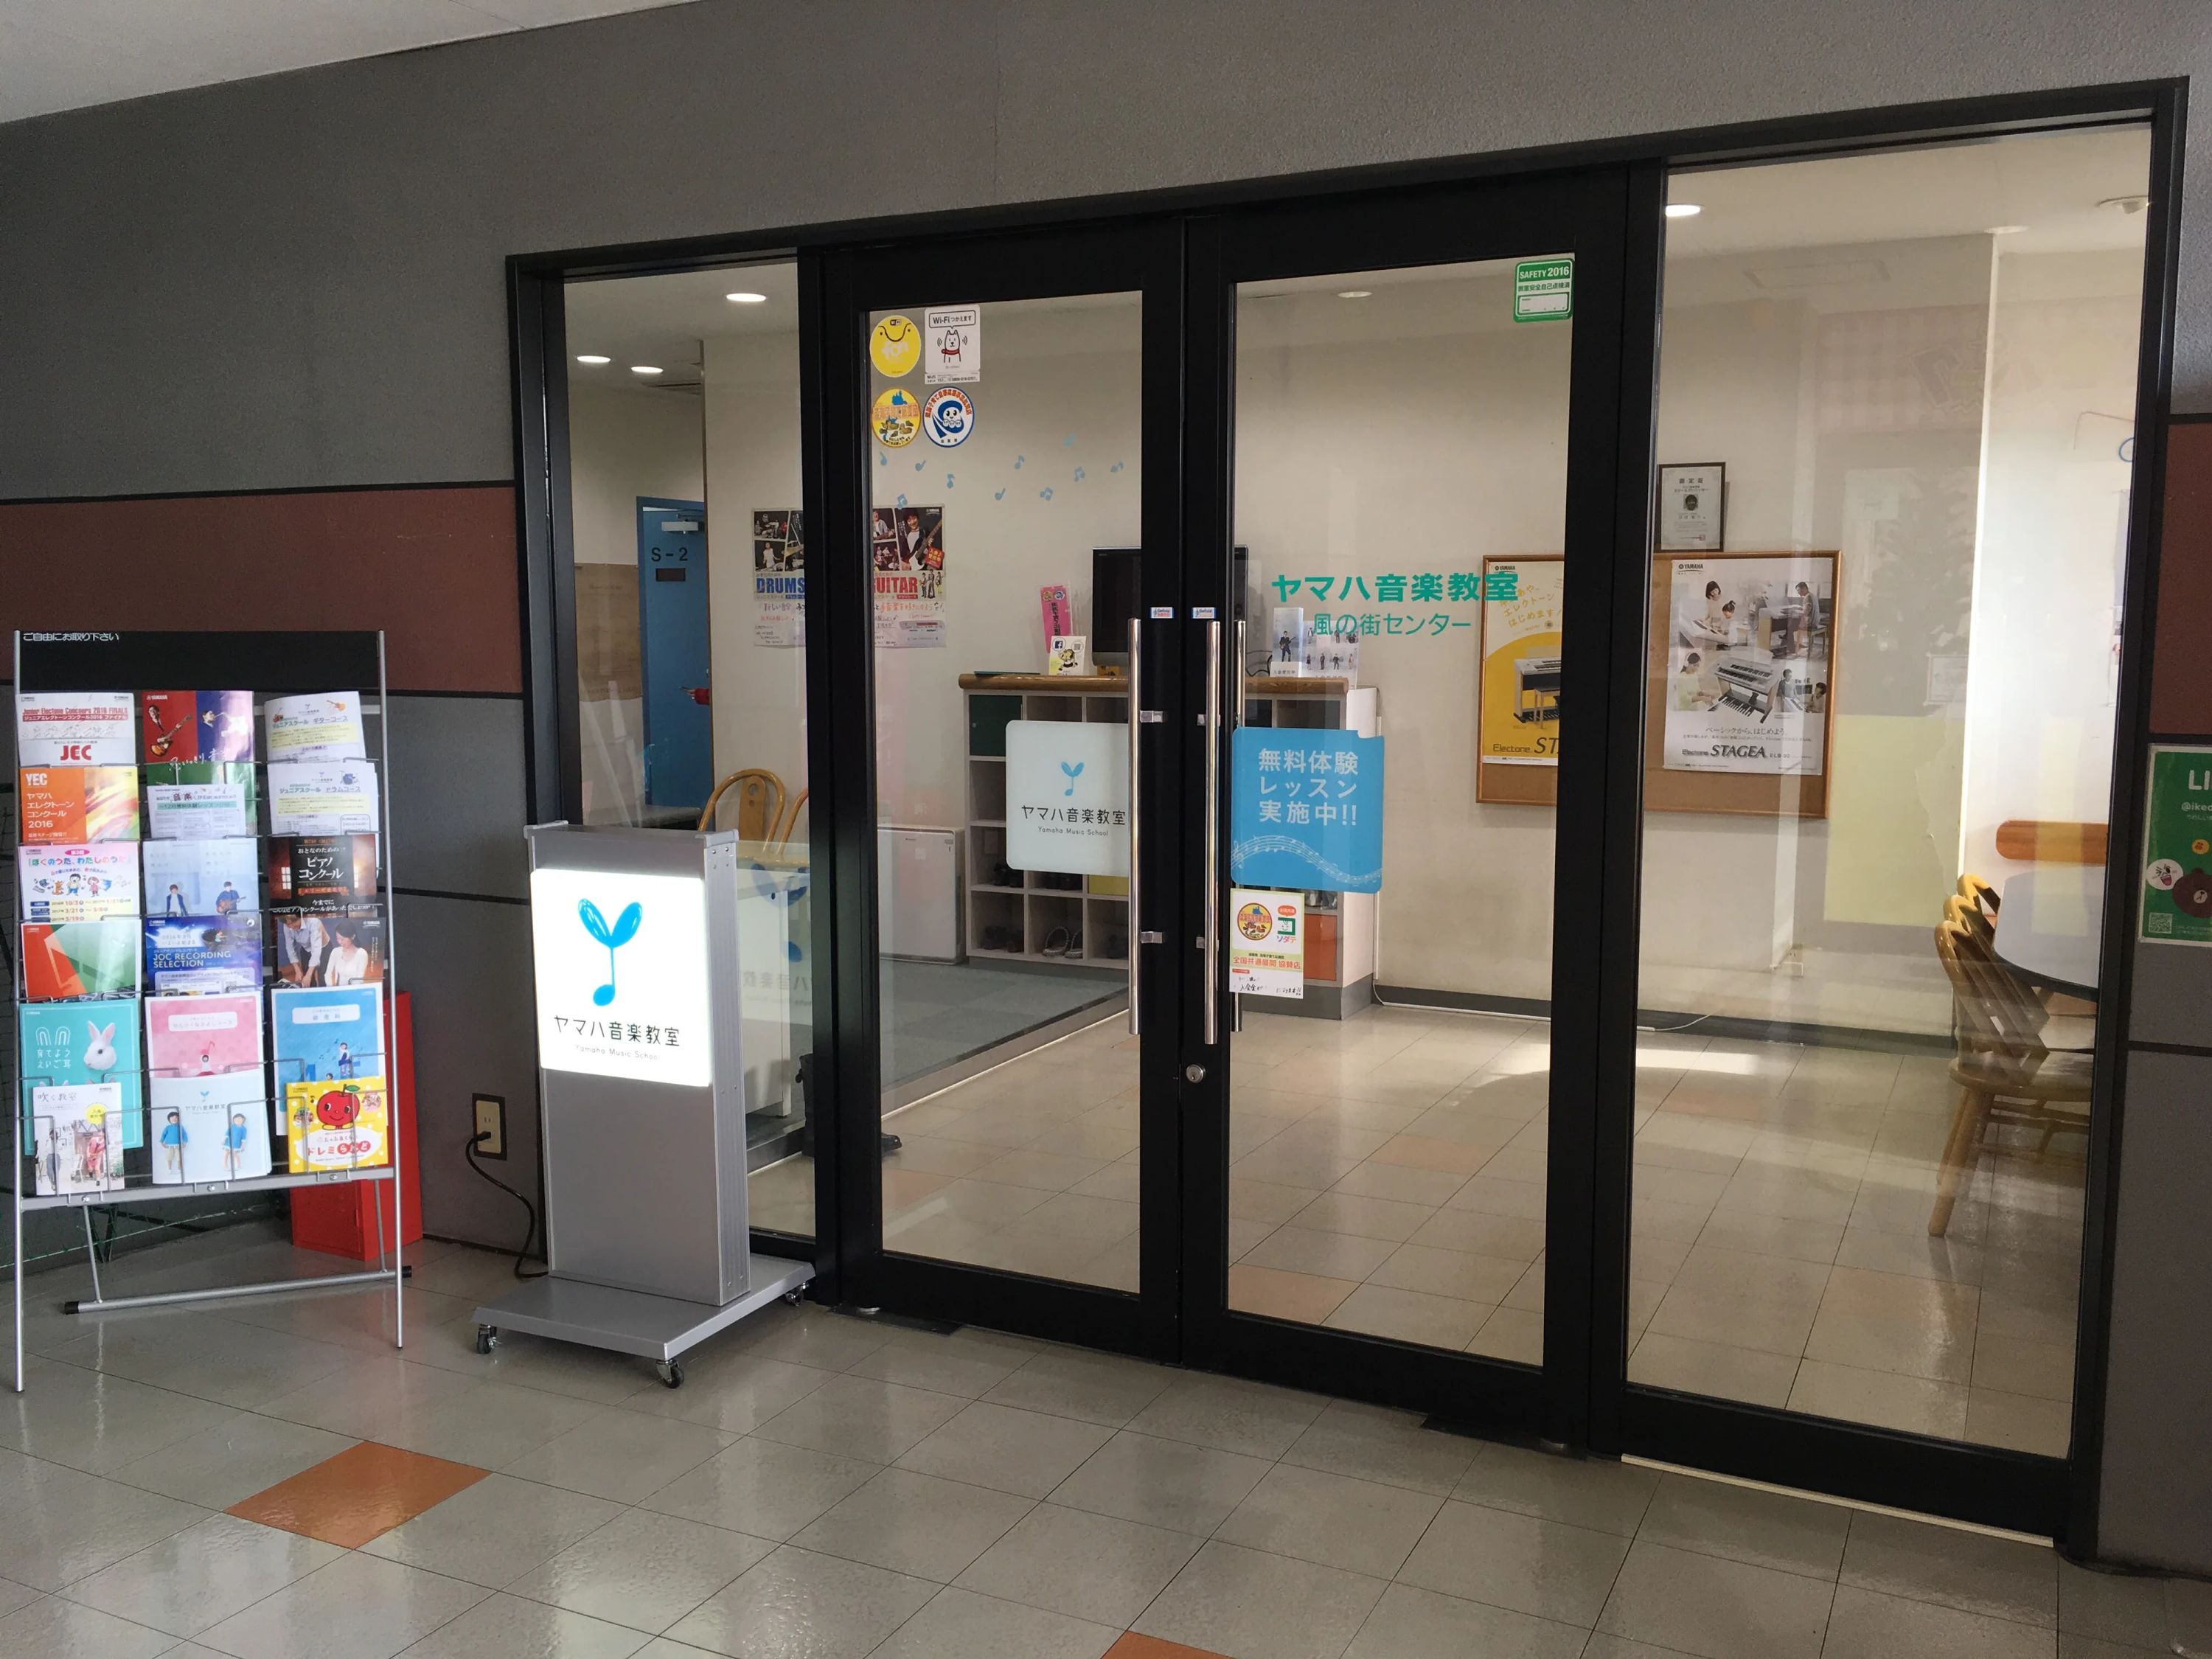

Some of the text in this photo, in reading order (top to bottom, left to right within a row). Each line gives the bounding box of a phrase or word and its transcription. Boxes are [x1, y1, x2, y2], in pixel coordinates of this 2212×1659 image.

[1520, 266, 1570, 279] SAFETY 2016
[651, 547, 688, 562] S-2
[757, 577, 804, 594] DRUMS
[873, 577, 918, 594] UITAR
[1271, 573, 1519, 602] ヤマハ音楽教室
[1312, 613, 1471, 636] 風の街センター
[23, 633, 119, 641] ご自由にお取り下さい
[313, 716, 349, 725] ギターコース
[1493, 737, 1559, 754] Electone ST
[1710, 745, 1767, 758] STAGEA
[60, 745, 91, 761] JEC
[1258, 748, 1359, 776] 無料体験
[25, 773, 48, 786] YEC
[1259, 776, 1357, 799] レッスン
[27, 801, 74, 809] エレクトーン
[1021, 804, 1126, 825] ヤマハ音楽教室
[1259, 799, 1357, 827] 実施中!!
[28, 820, 53, 829] 2016
[1037, 826, 1063, 834] Yamaha
[307, 856, 333, 868] ピアノ
[299, 868, 344, 880] コンクール
[153, 950, 232, 961] JOC RECORDING
[153, 960, 204, 969] SELECTION
[1233, 956, 1301, 970] 全国共通展開 協賛店
[554, 1015, 680, 1047] ヤマハ音楽教室
[37, 1048, 71, 1058] 育てよう
[575, 1044, 605, 1054] Yamaha
[609, 1048, 631, 1057] Music
[37, 1059, 71, 1069] えいご耳
[38, 1092, 77, 1102] 吹く教室
